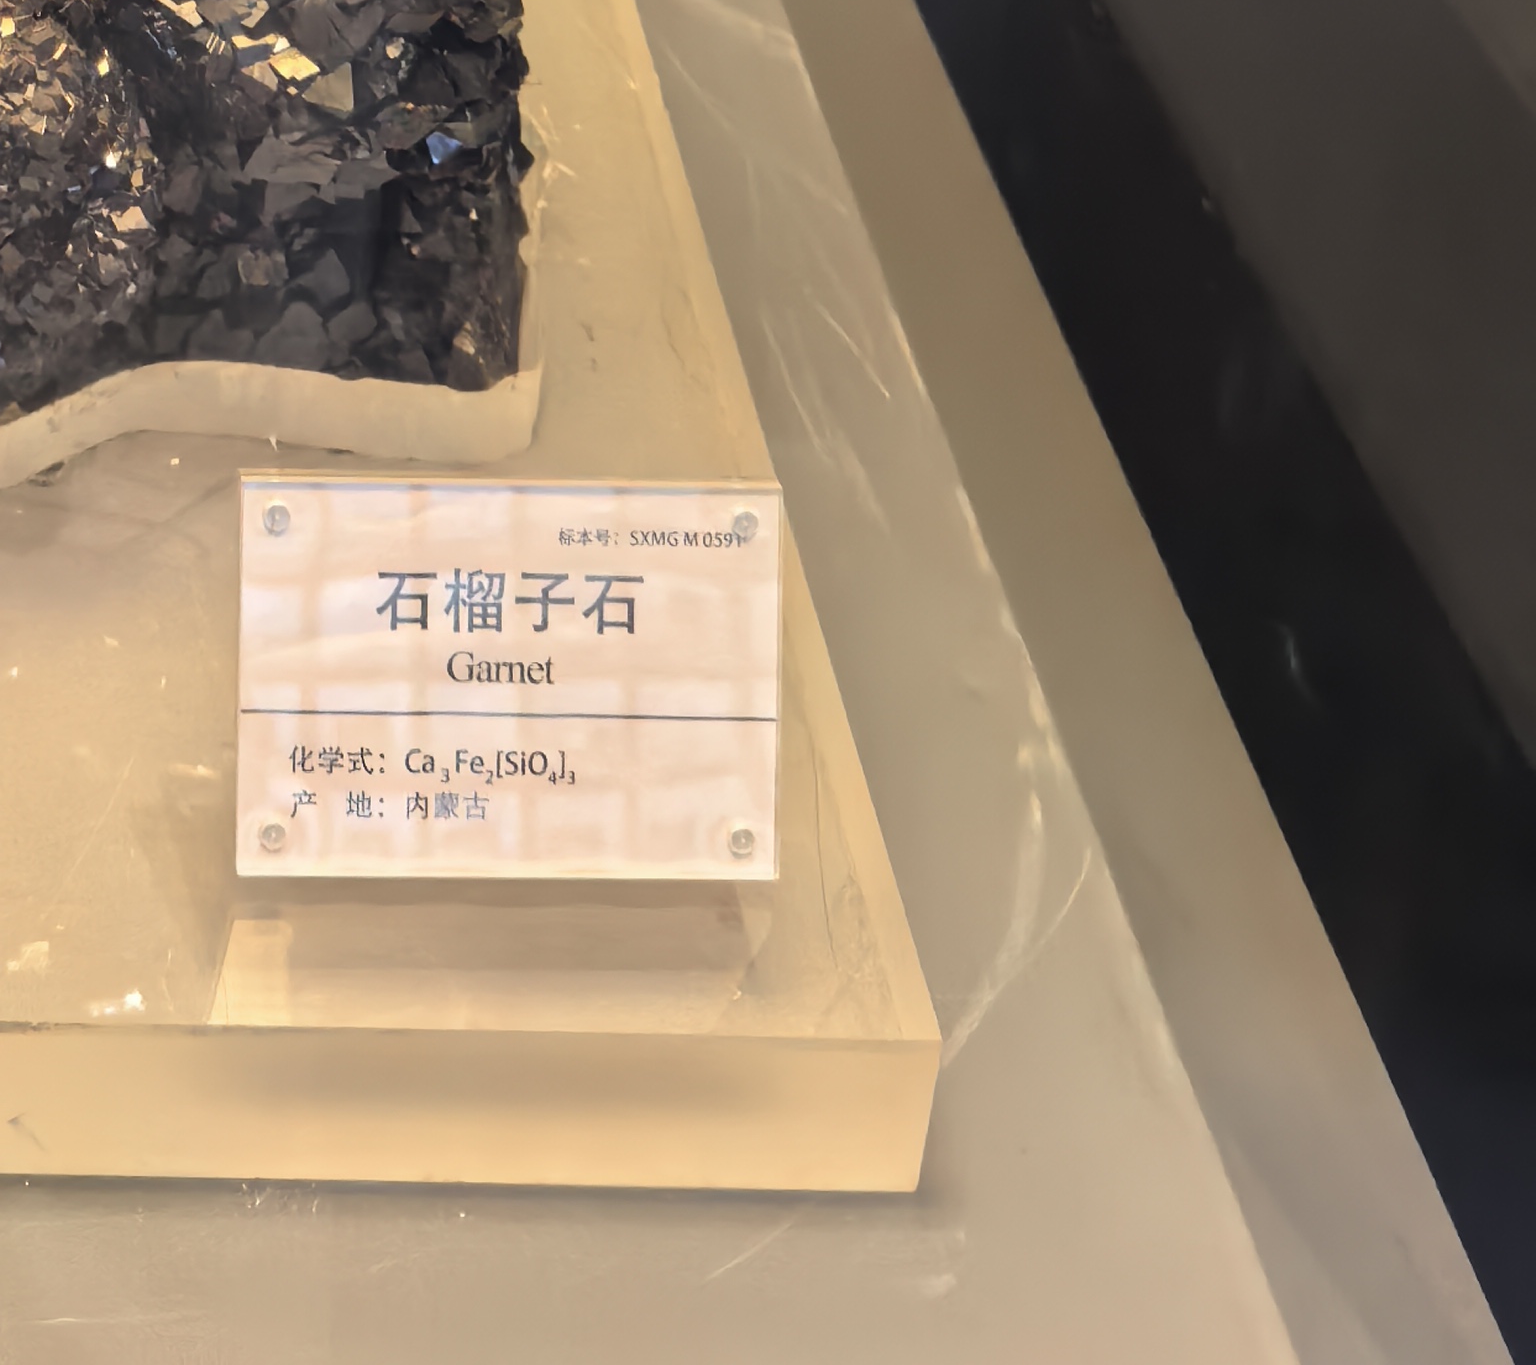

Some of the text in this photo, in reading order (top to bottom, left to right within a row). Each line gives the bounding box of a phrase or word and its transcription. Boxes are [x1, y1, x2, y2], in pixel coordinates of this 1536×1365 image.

[376, 568, 644, 635] 石榴子石
[446, 651, 555, 685] Garnet
